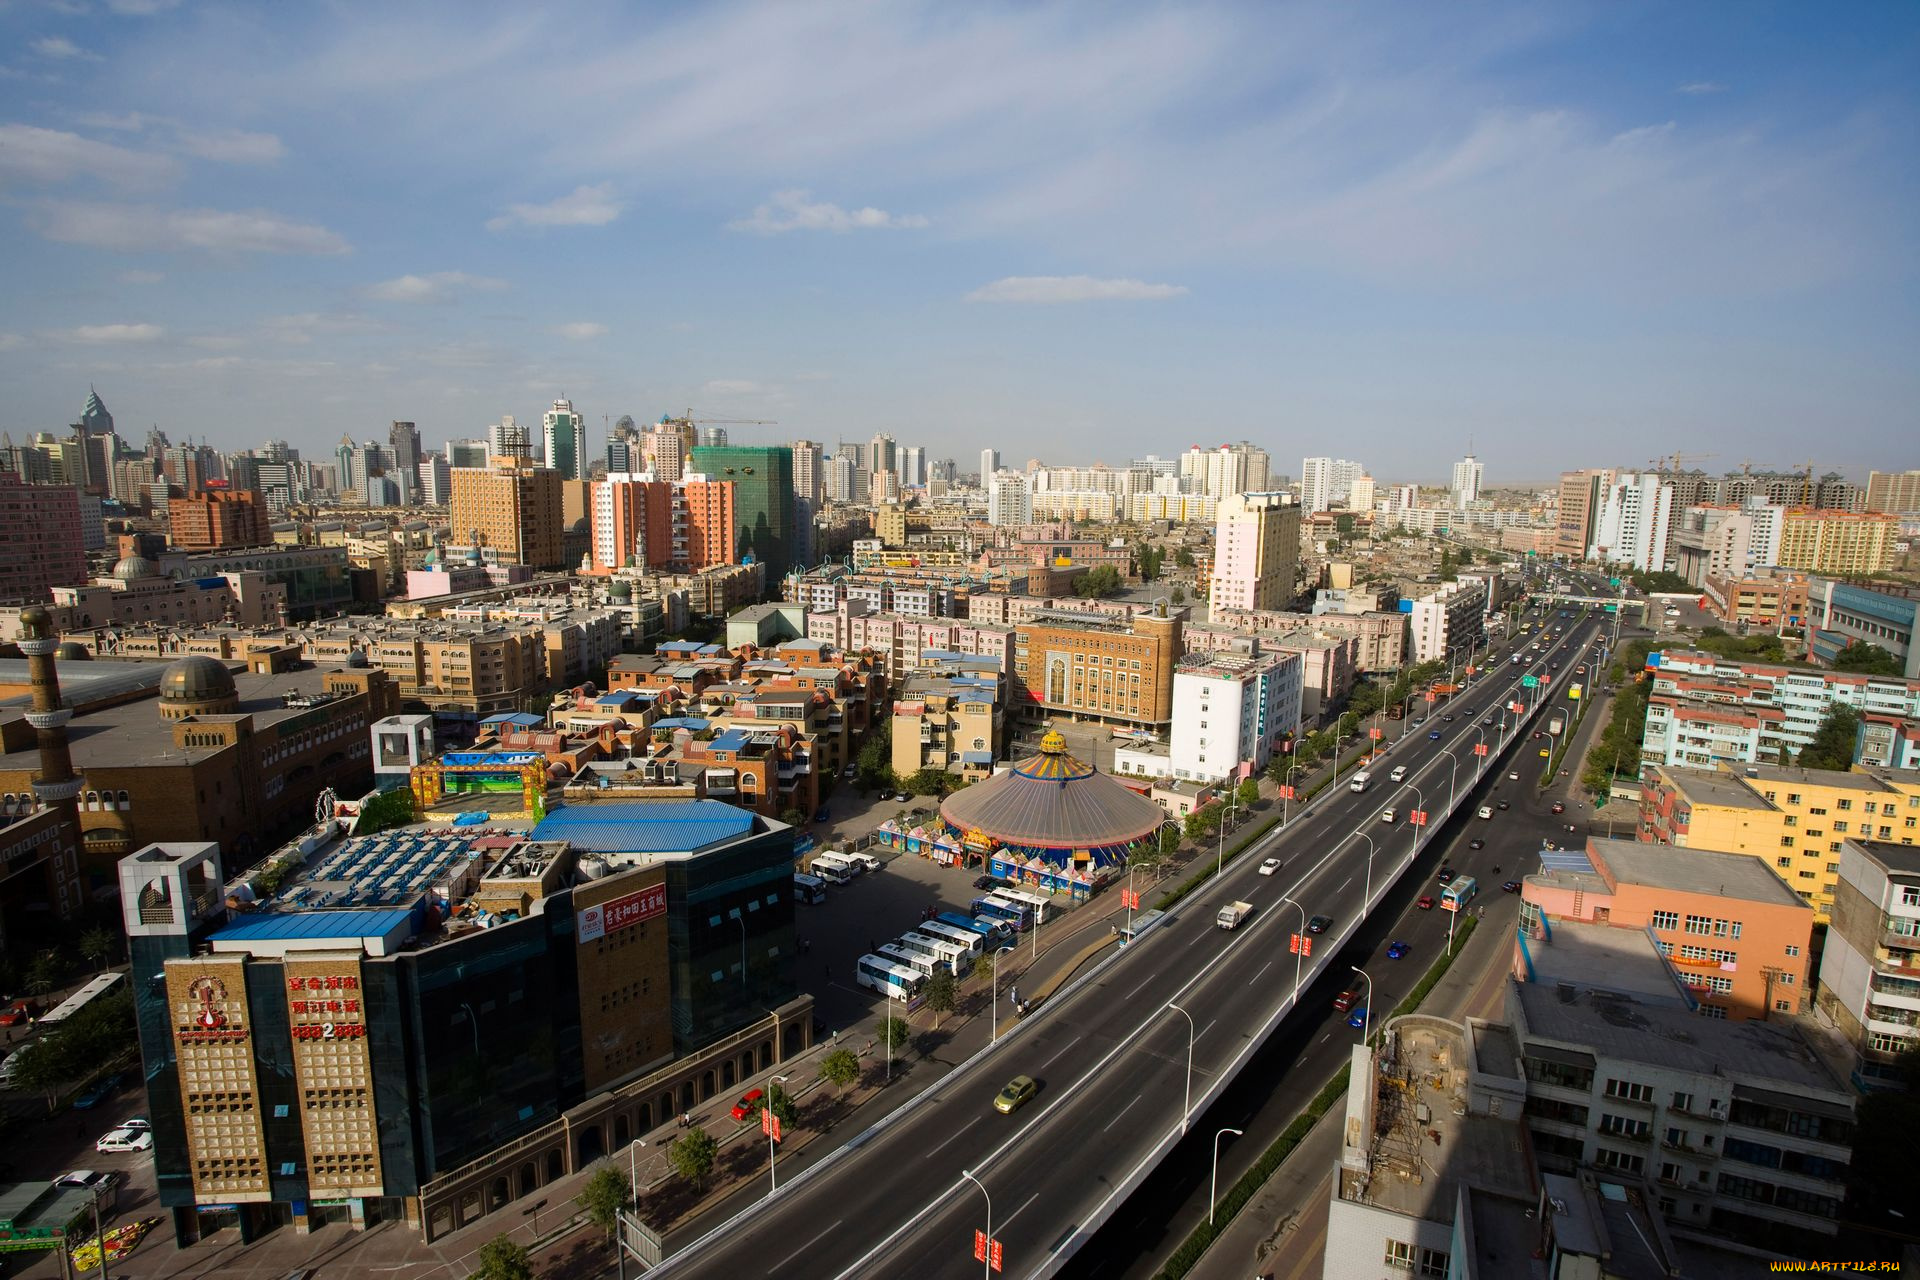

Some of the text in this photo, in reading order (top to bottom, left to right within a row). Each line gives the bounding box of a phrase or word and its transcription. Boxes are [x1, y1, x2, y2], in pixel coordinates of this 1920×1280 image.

[289, 976, 356, 990] 宴会演出
[291, 1000, 357, 1013] 预订电话
